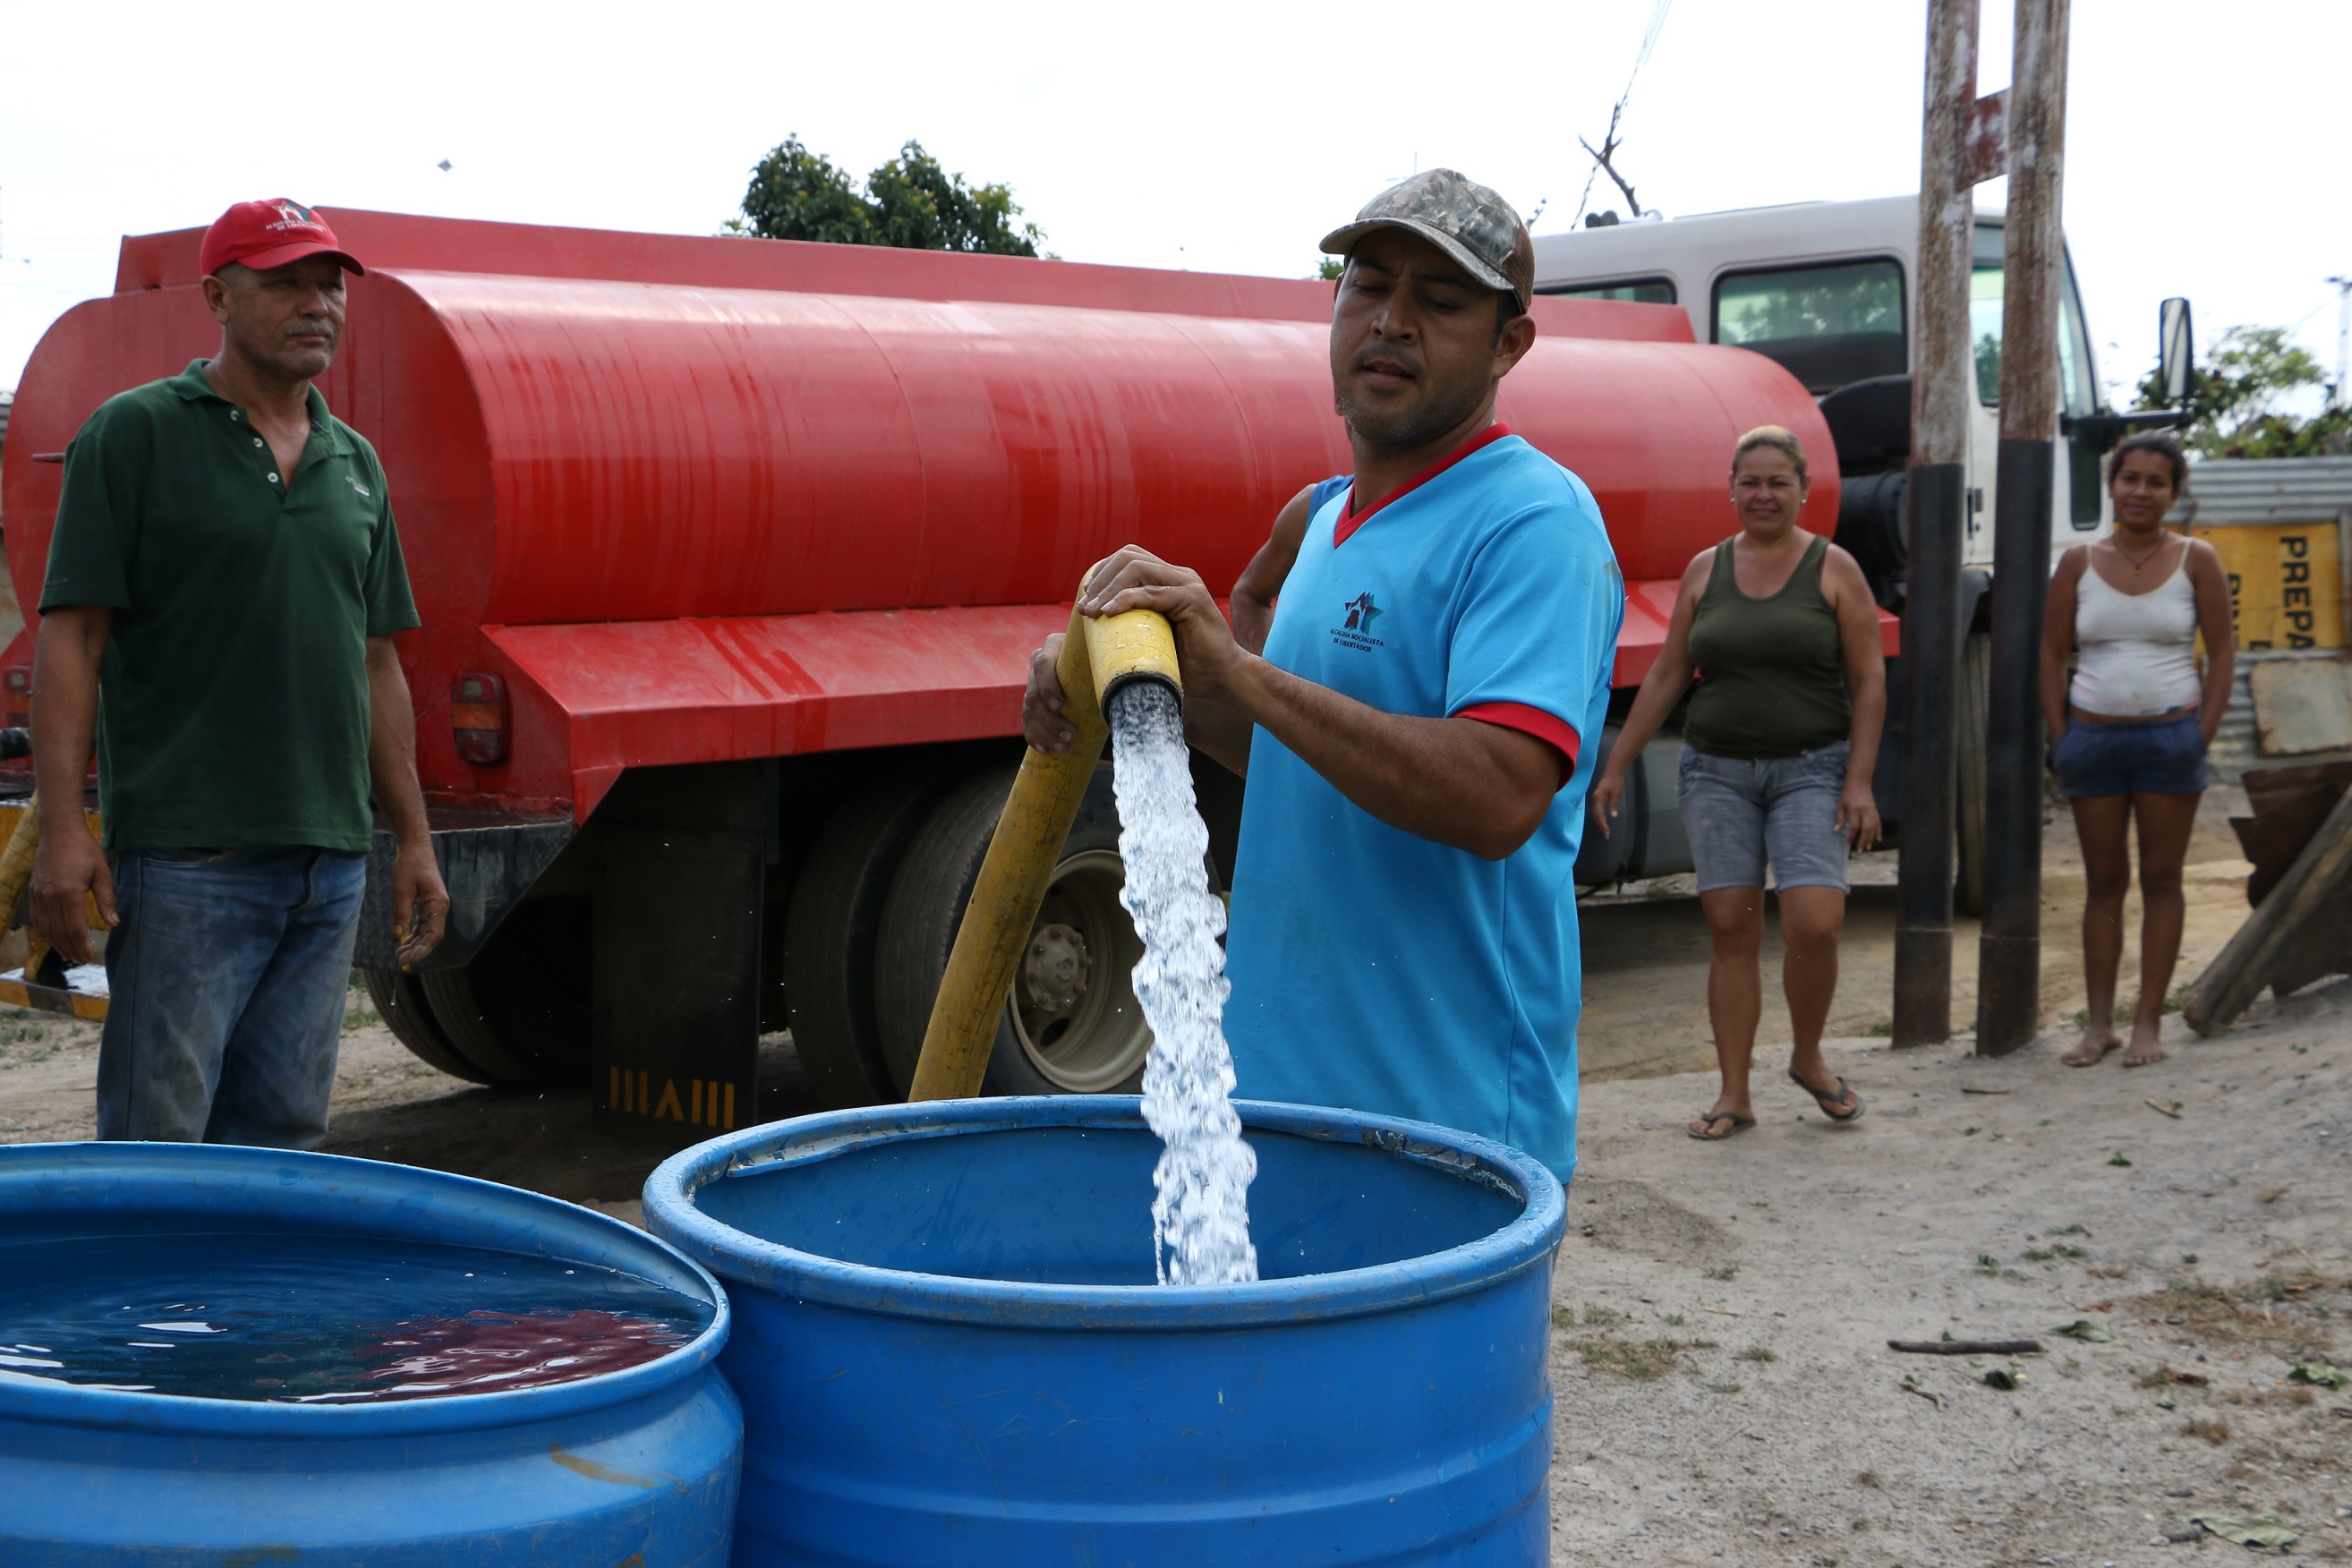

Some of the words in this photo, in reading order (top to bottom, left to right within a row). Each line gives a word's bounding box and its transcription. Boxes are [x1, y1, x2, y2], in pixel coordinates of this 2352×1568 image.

[1330, 628, 1350, 638] ALCALDIA
[1351, 633, 1384, 646] SOCIALISTA
[1339, 639, 1372, 652] LIBERTADOR
